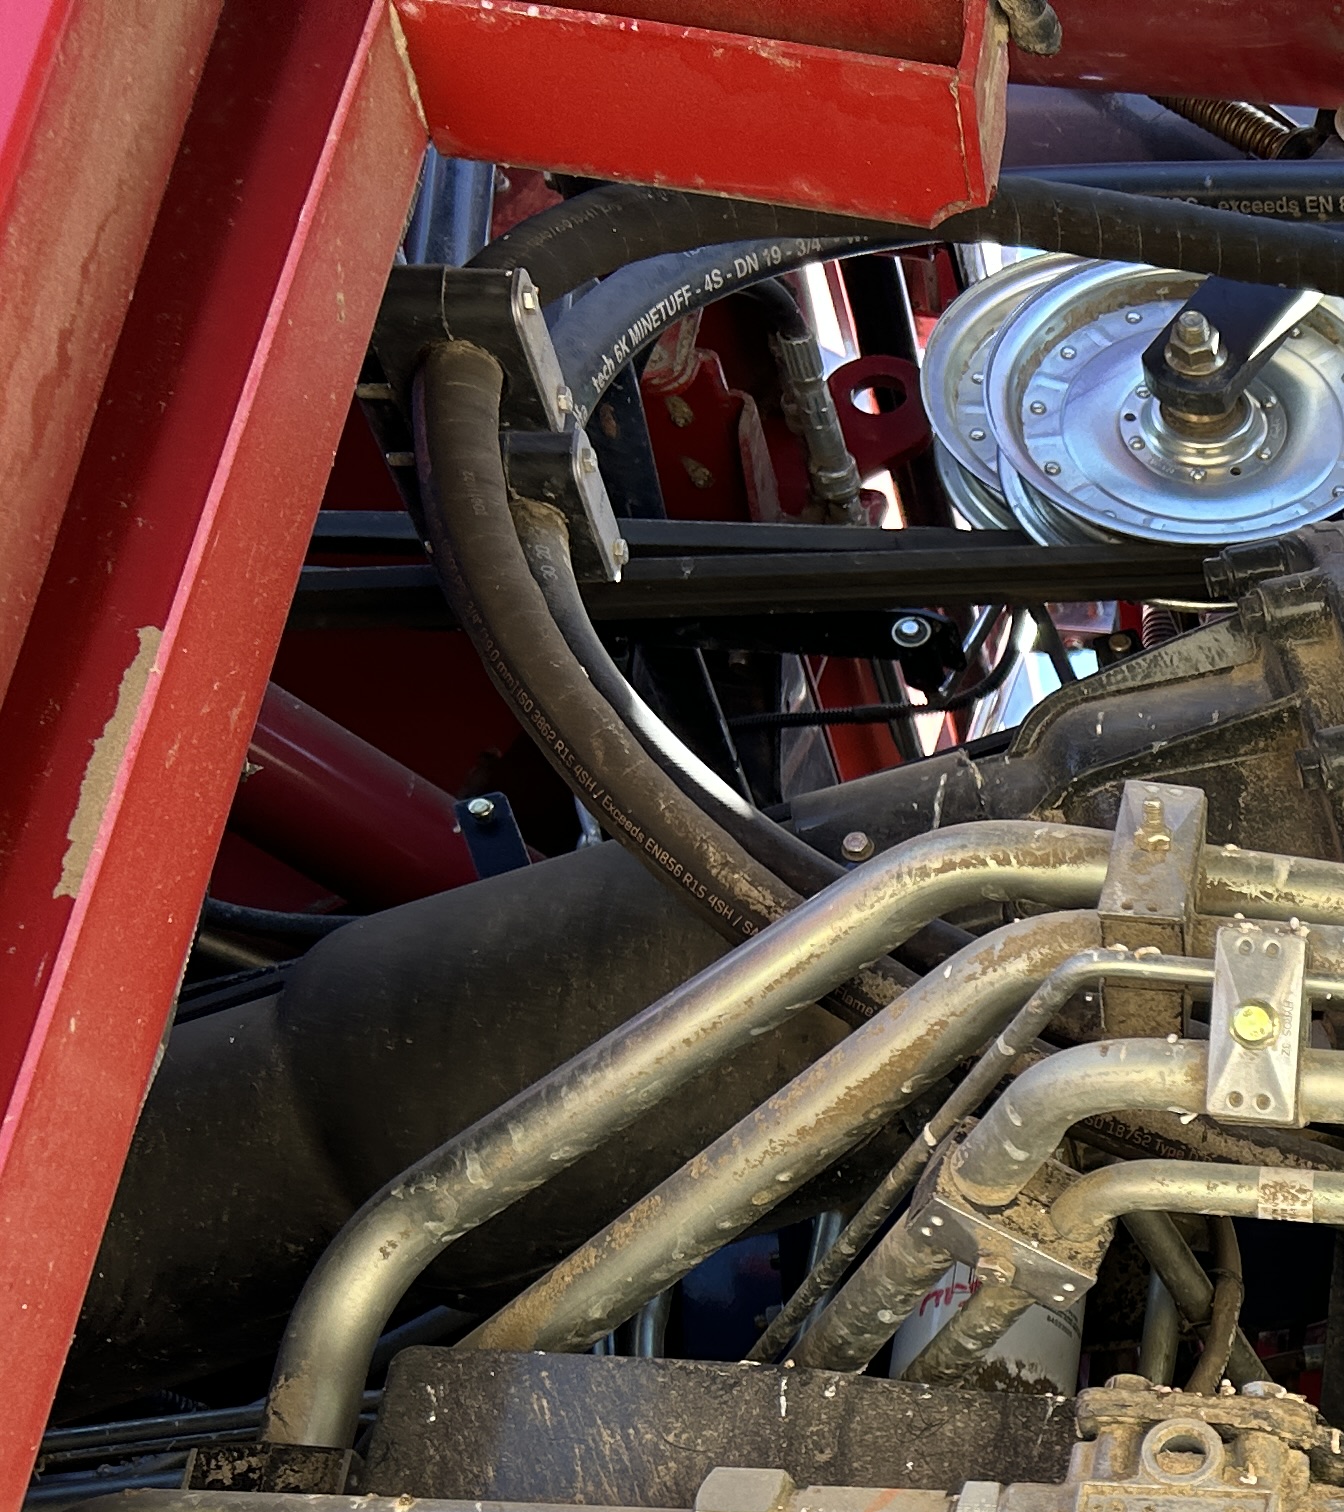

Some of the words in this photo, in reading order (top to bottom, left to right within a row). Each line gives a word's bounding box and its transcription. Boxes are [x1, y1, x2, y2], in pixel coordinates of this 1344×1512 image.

[1305, 195, 1334, 213] EN
[613, 334, 631, 362] 6K
[627, 284, 693, 346] MINETUFF
[703, 267, 724, 293] 4S
[734, 252, 760, 279] DN
[762, 245, 782, 265] 19
[530, 706, 556, 743] 3862
[554, 739, 576, 770] R15
[573, 762, 598, 795] 4SH
[601, 793, 646, 843] Exceeds
[682, 868, 708, 899] R15
[707, 892, 736, 922] 4SH
[1153, 1136, 1187, 1162] Type
